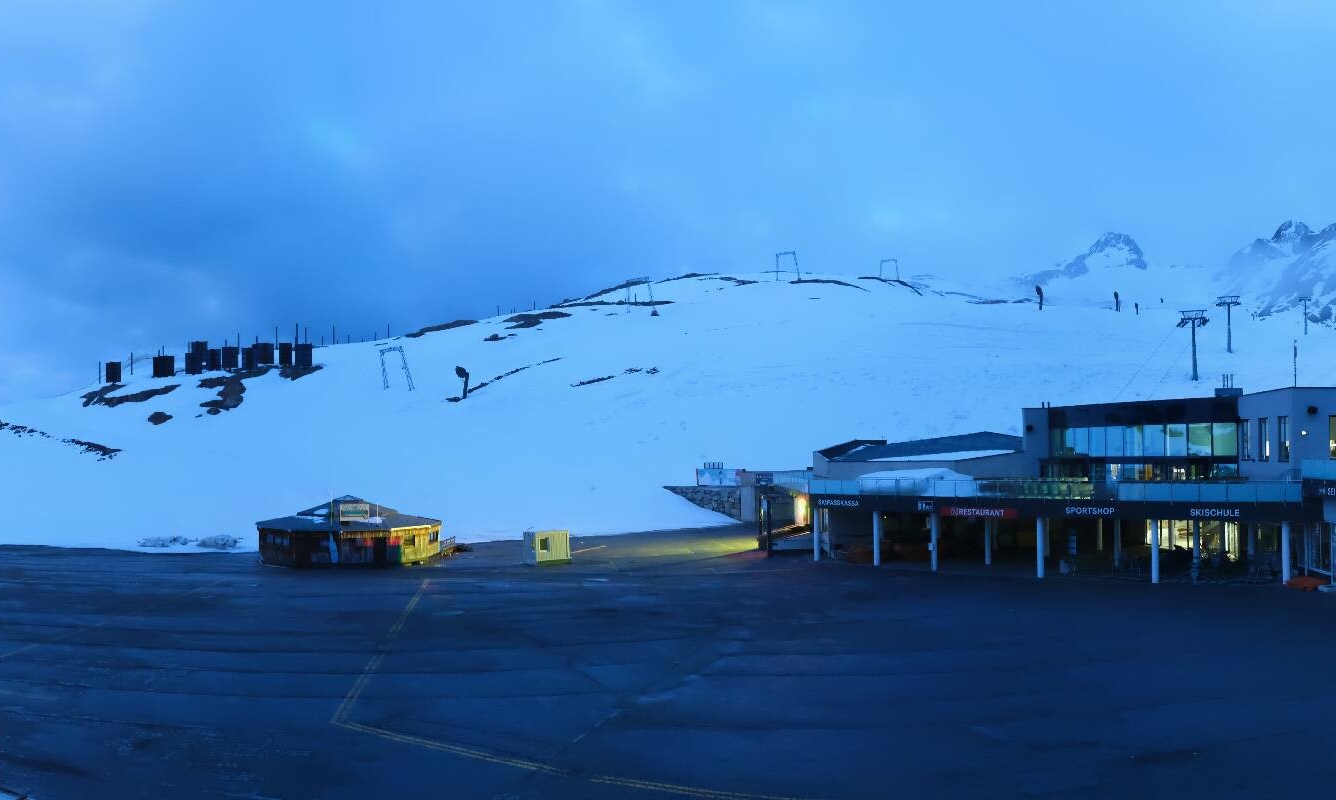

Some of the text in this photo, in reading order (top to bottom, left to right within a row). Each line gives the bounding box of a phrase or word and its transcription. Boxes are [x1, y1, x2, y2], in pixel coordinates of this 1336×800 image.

[958, 508, 1005, 517] RESTAURANT
[1065, 506, 1114, 516] SPORTSHOP
[1190, 508, 1240, 517] SKISCHULE
